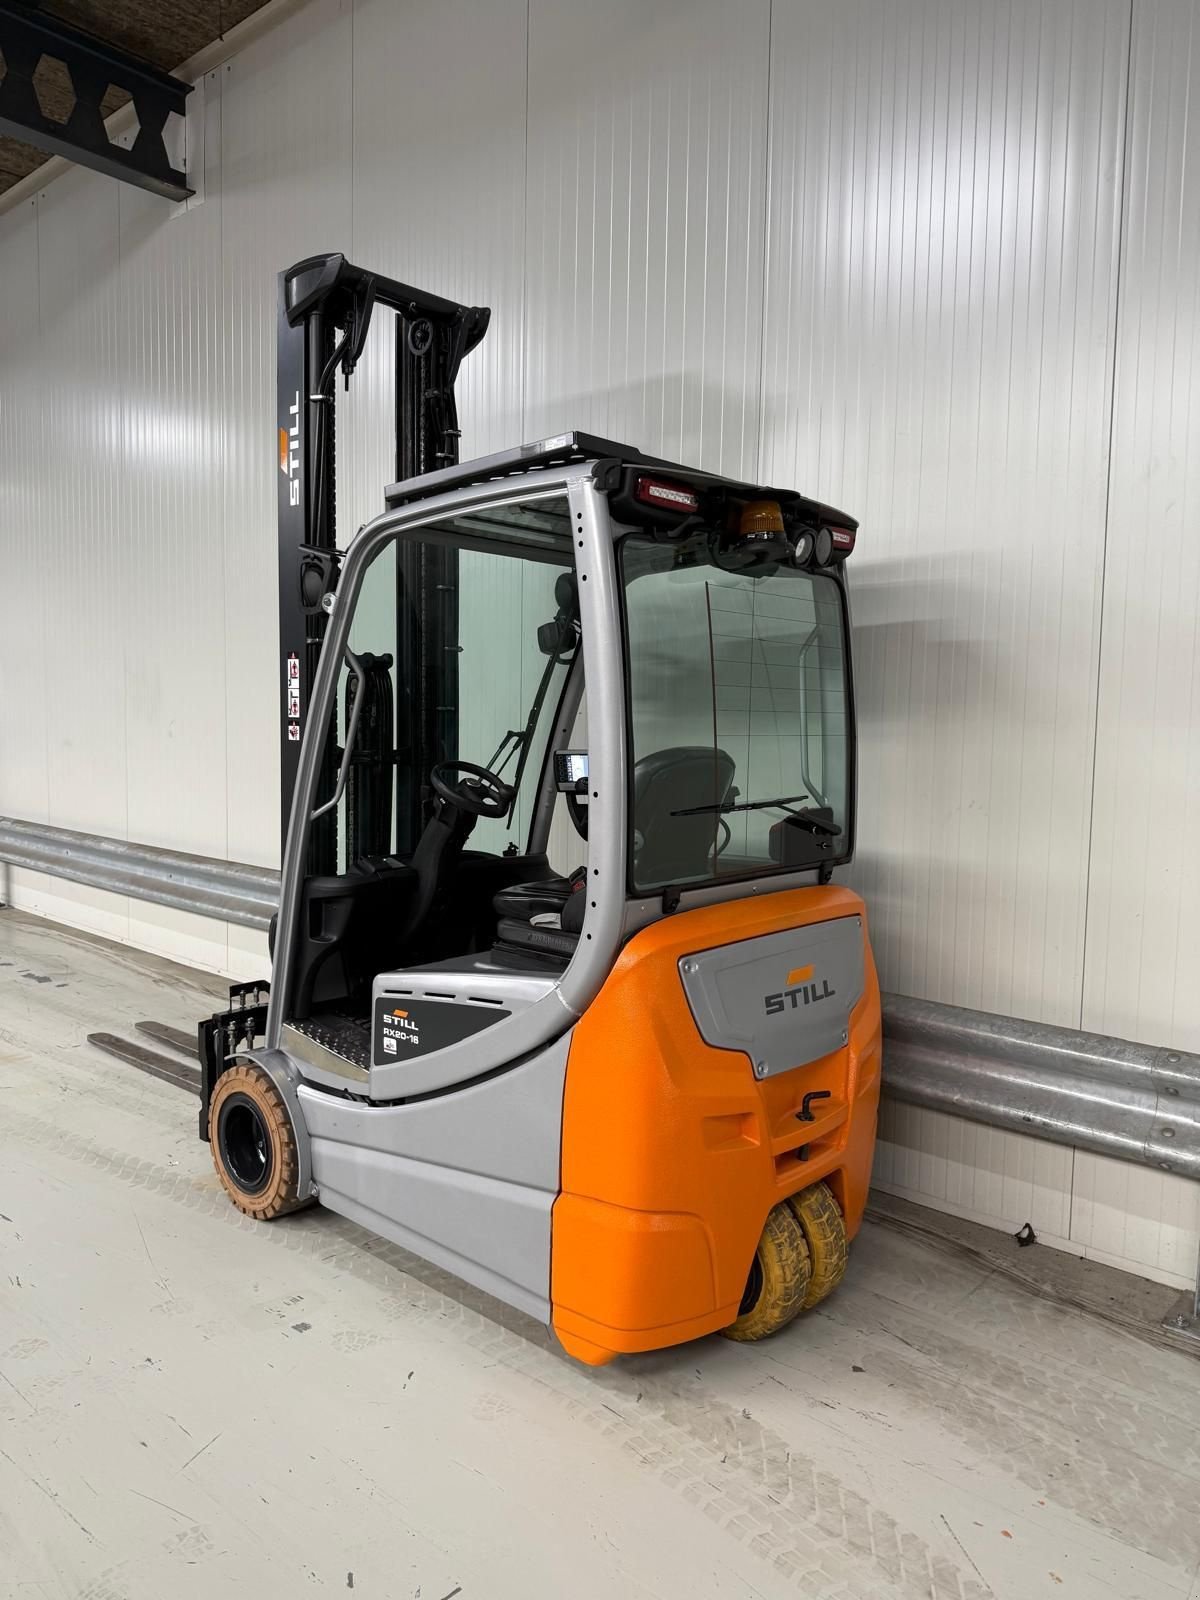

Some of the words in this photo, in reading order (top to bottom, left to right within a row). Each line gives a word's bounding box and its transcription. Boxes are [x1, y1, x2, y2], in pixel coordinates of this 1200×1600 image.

[289, 390, 299, 506] STILL
[765, 980, 836, 1015] STILL
[383, 1014, 419, 1031] STILL
